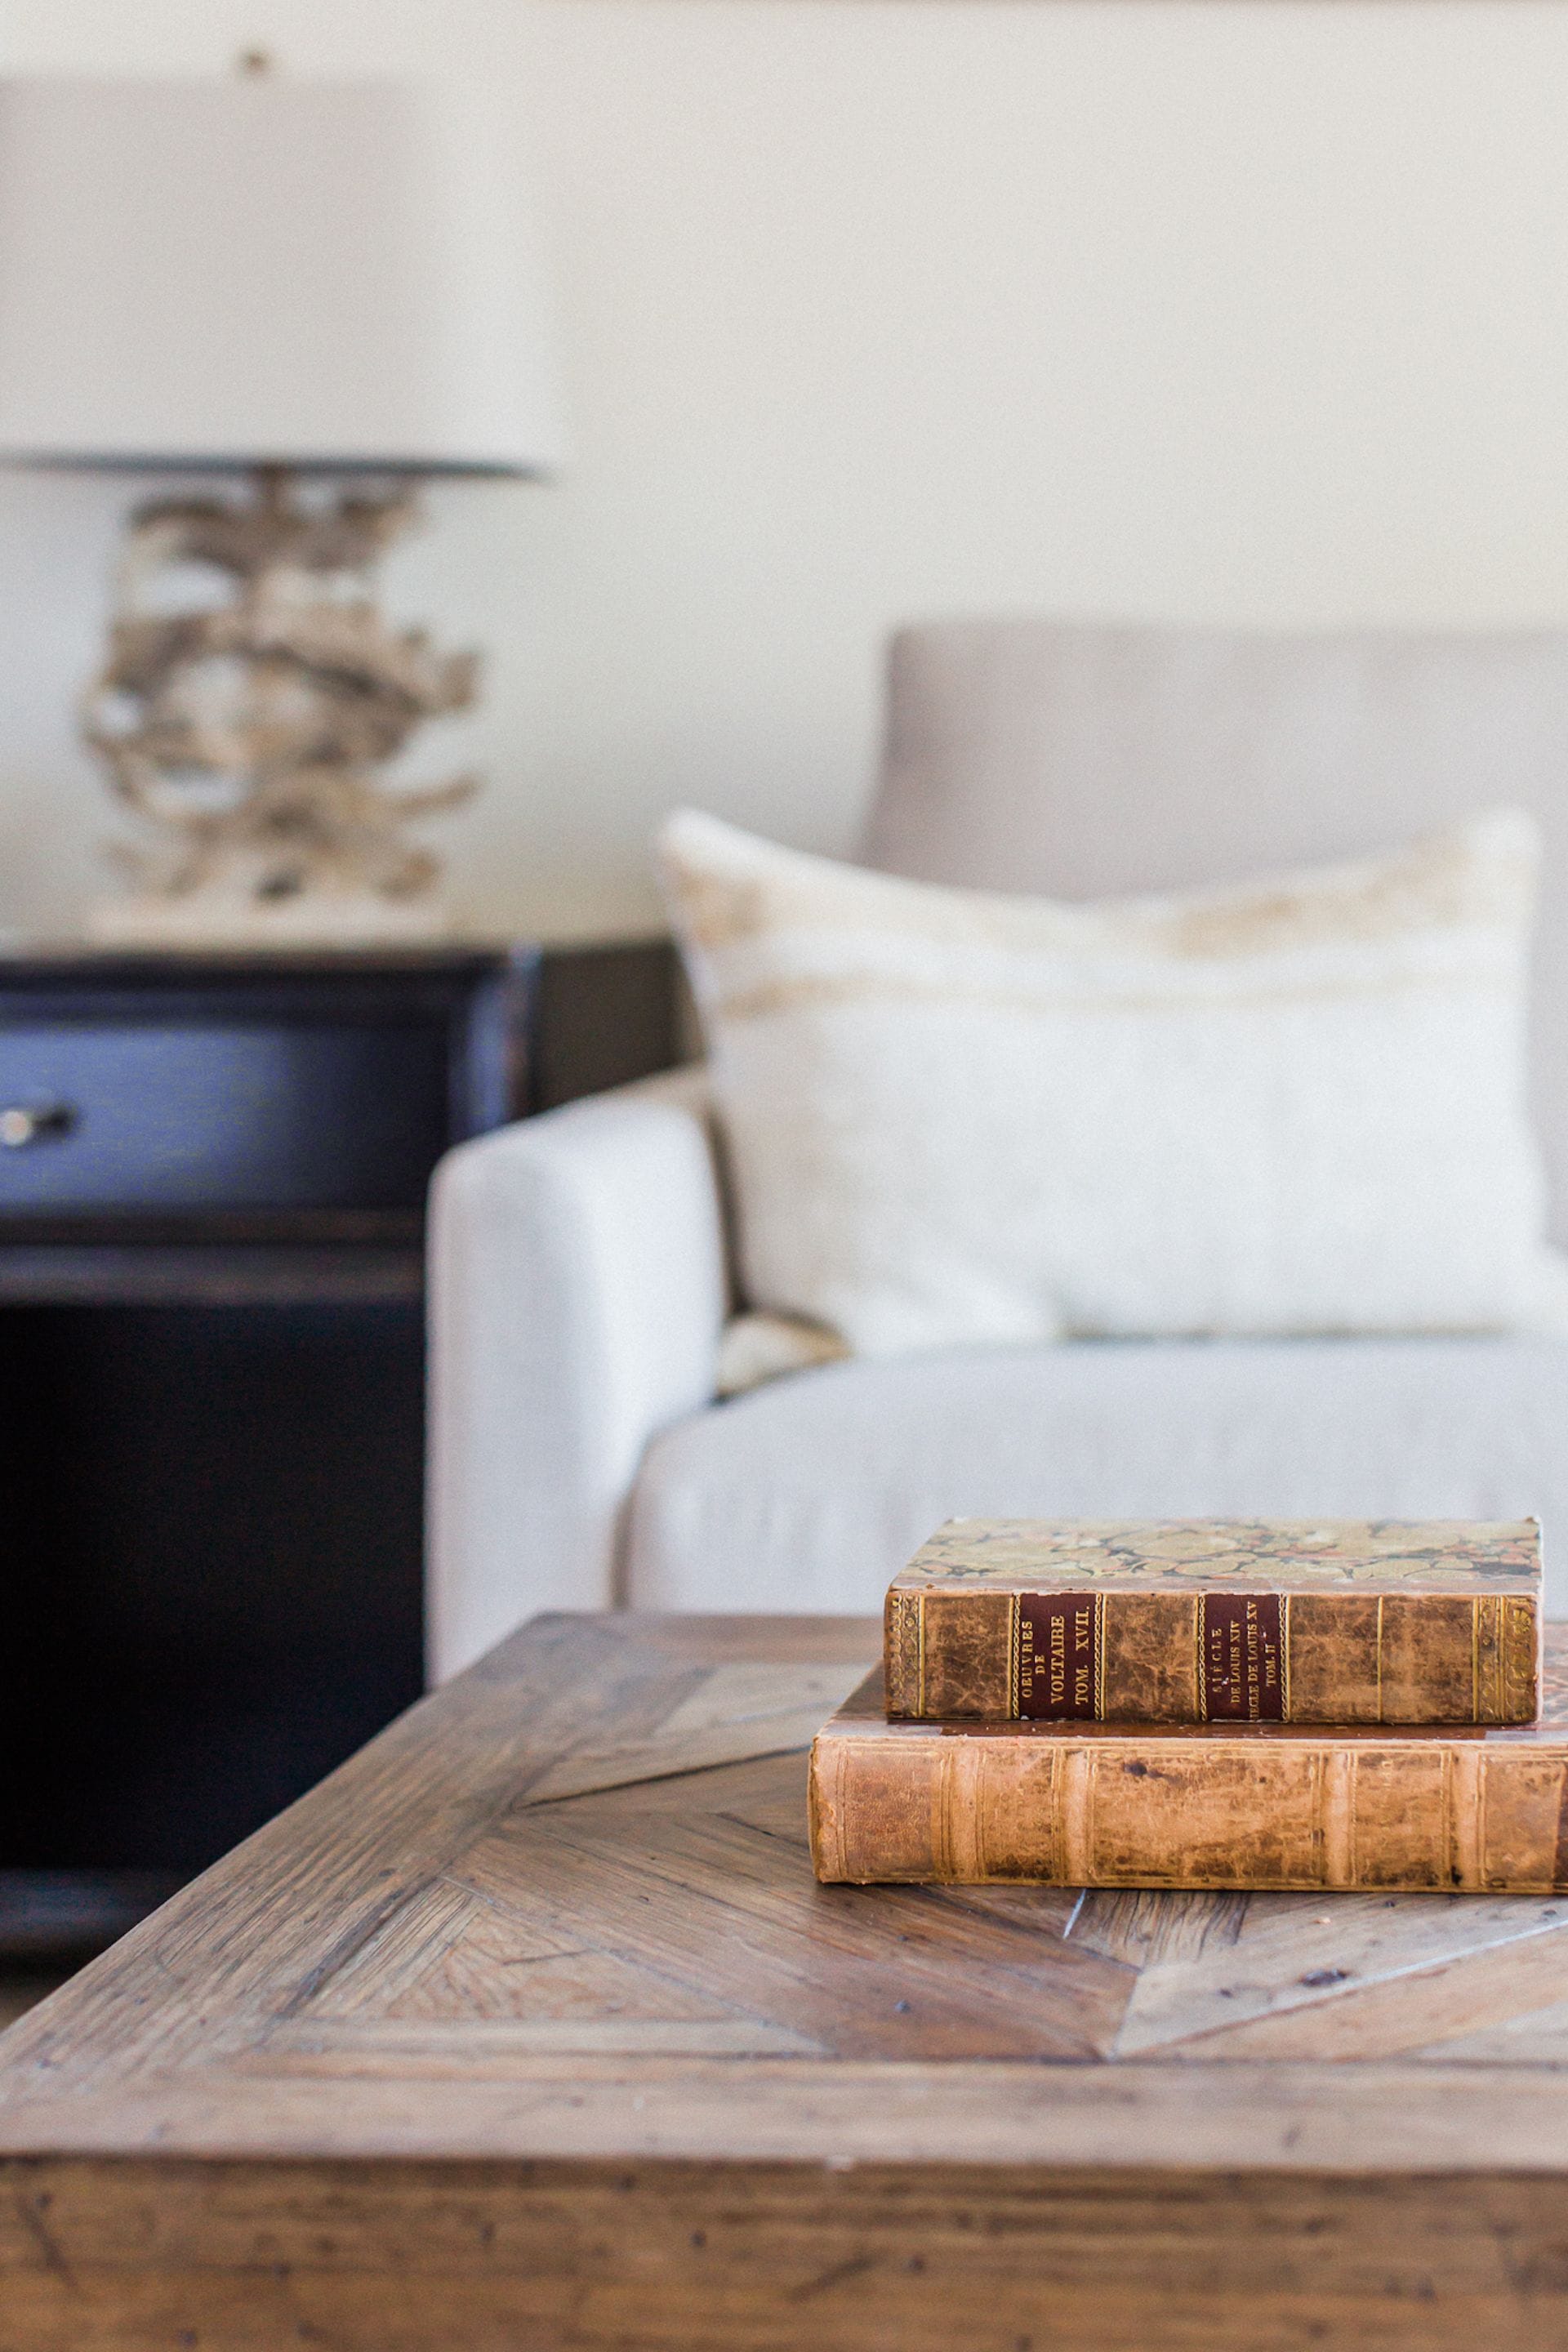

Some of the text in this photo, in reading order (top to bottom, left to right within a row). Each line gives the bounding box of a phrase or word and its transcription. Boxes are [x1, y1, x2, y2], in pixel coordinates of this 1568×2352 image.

[1246, 1601, 1258, 1620] XV
[1022, 1621, 1033, 1699] OEUVRES
[1051, 1615, 1064, 1704] VOLTAIRE
[1075, 1606, 1090, 1705] TOM. XVII.
[1247, 1624, 1258, 1661] LOUIS
[1035, 1655, 1045, 1675] DE
[1229, 1620, 1241, 1704] DE LOUIS XIV
[1248, 1665, 1258, 1682] DE
[1266, 1656, 1276, 1687] TOM.
